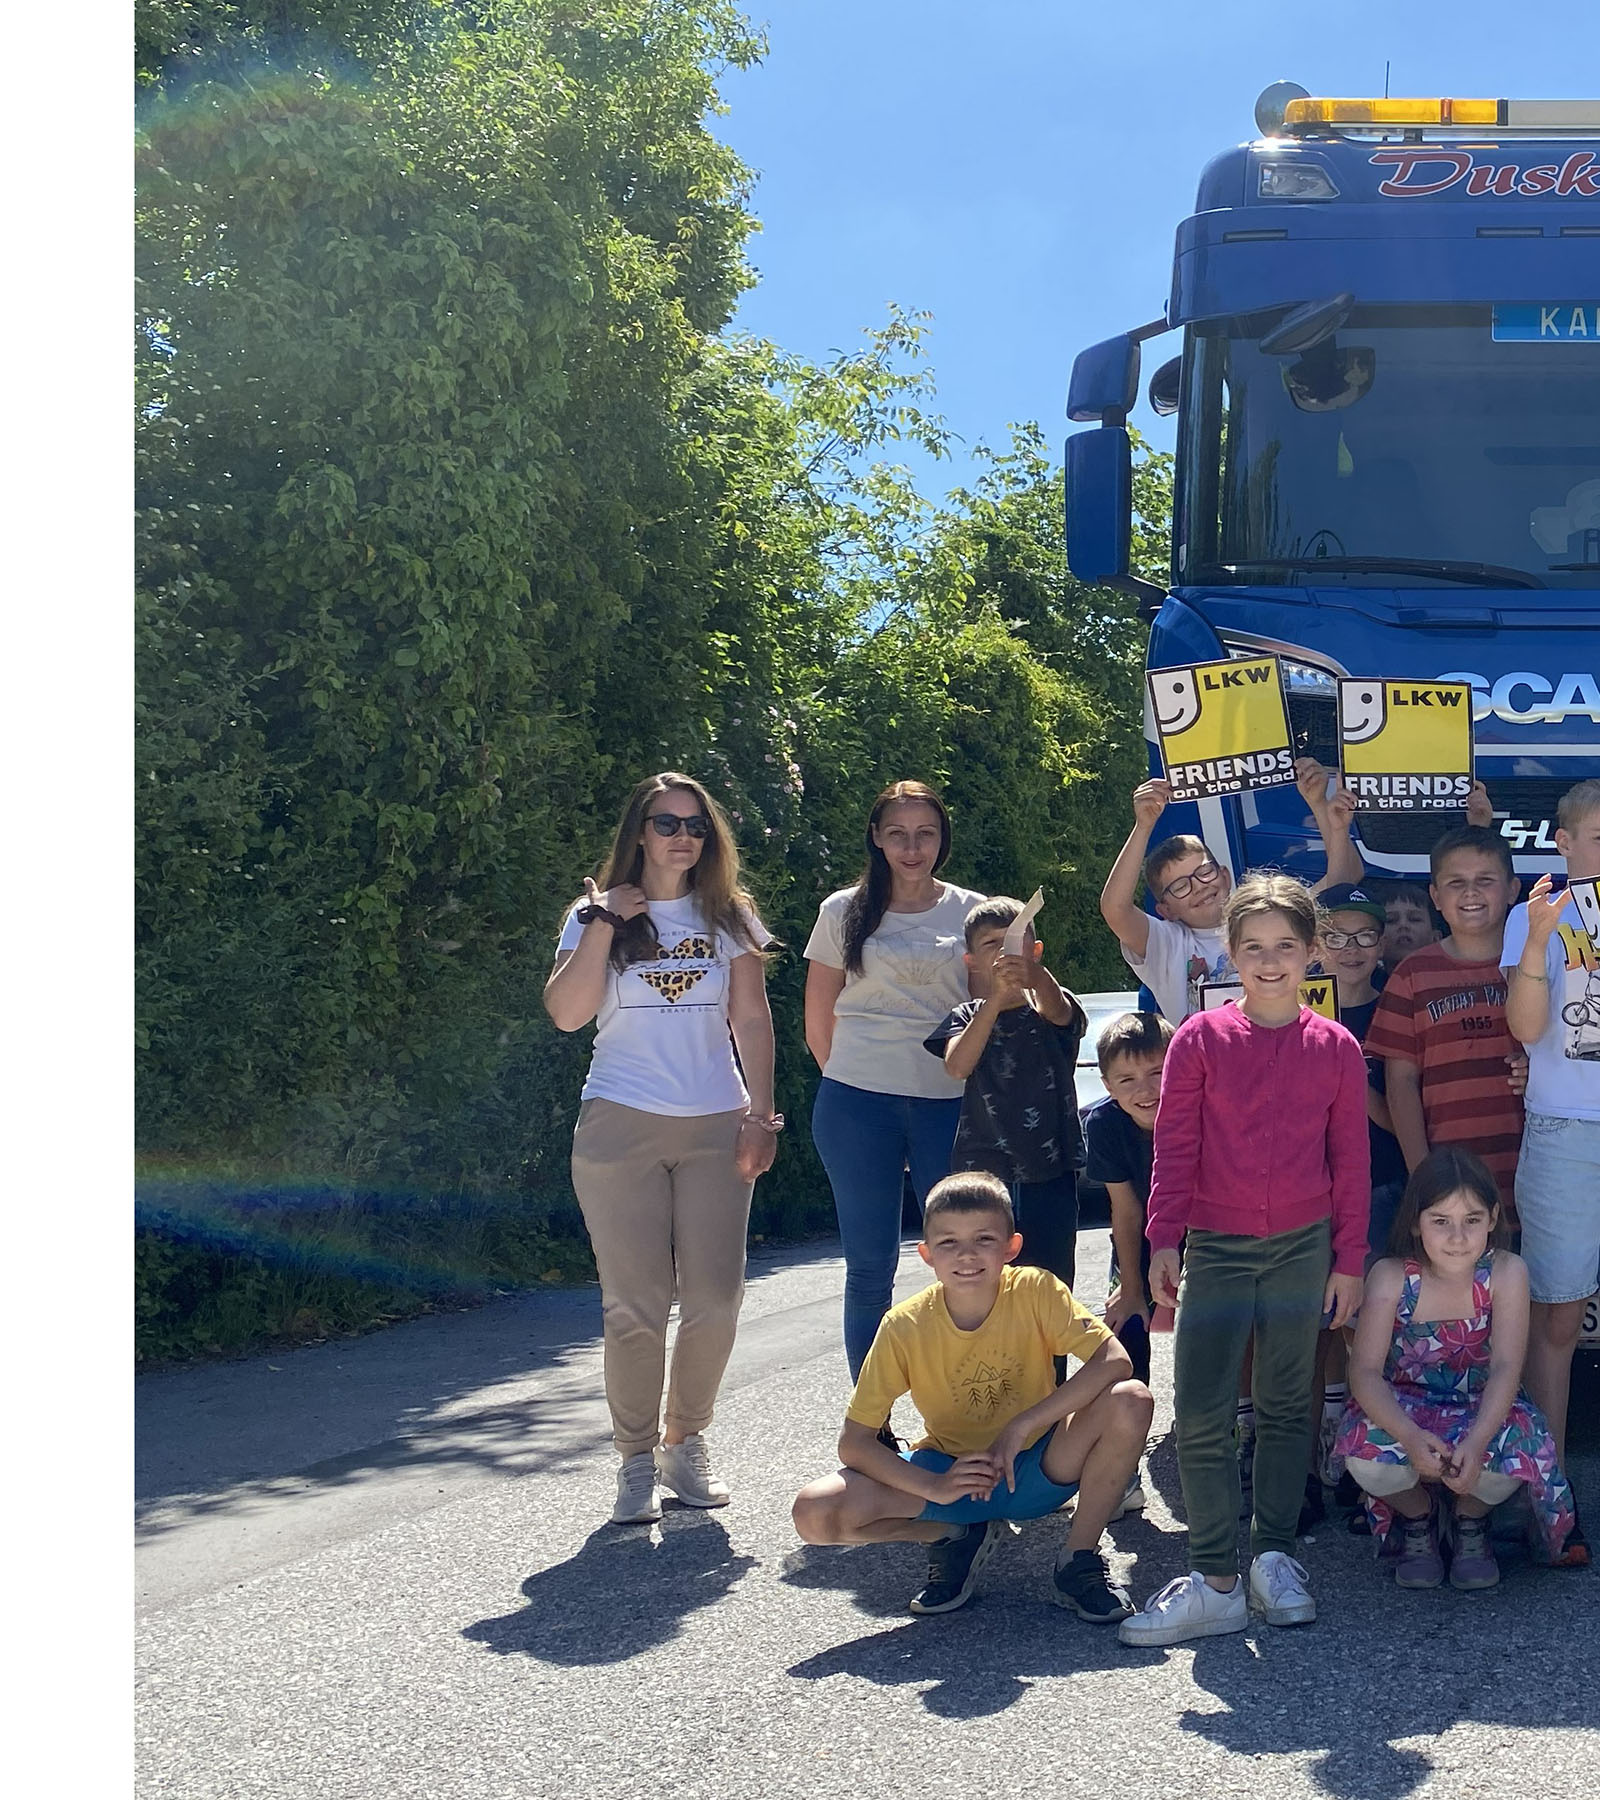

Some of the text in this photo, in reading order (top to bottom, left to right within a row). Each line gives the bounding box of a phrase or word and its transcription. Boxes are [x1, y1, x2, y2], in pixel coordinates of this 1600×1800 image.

[1203, 666, 1271, 690] LKW
[1393, 690, 1462, 707] LKW
[1168, 750, 1293, 787] FRIENDS
[1173, 768, 1295, 799] on the road
[1345, 776, 1471, 796] FRIENDS
[1378, 797, 1414, 808] the
[1461, 1016, 1492, 1031] 1955
